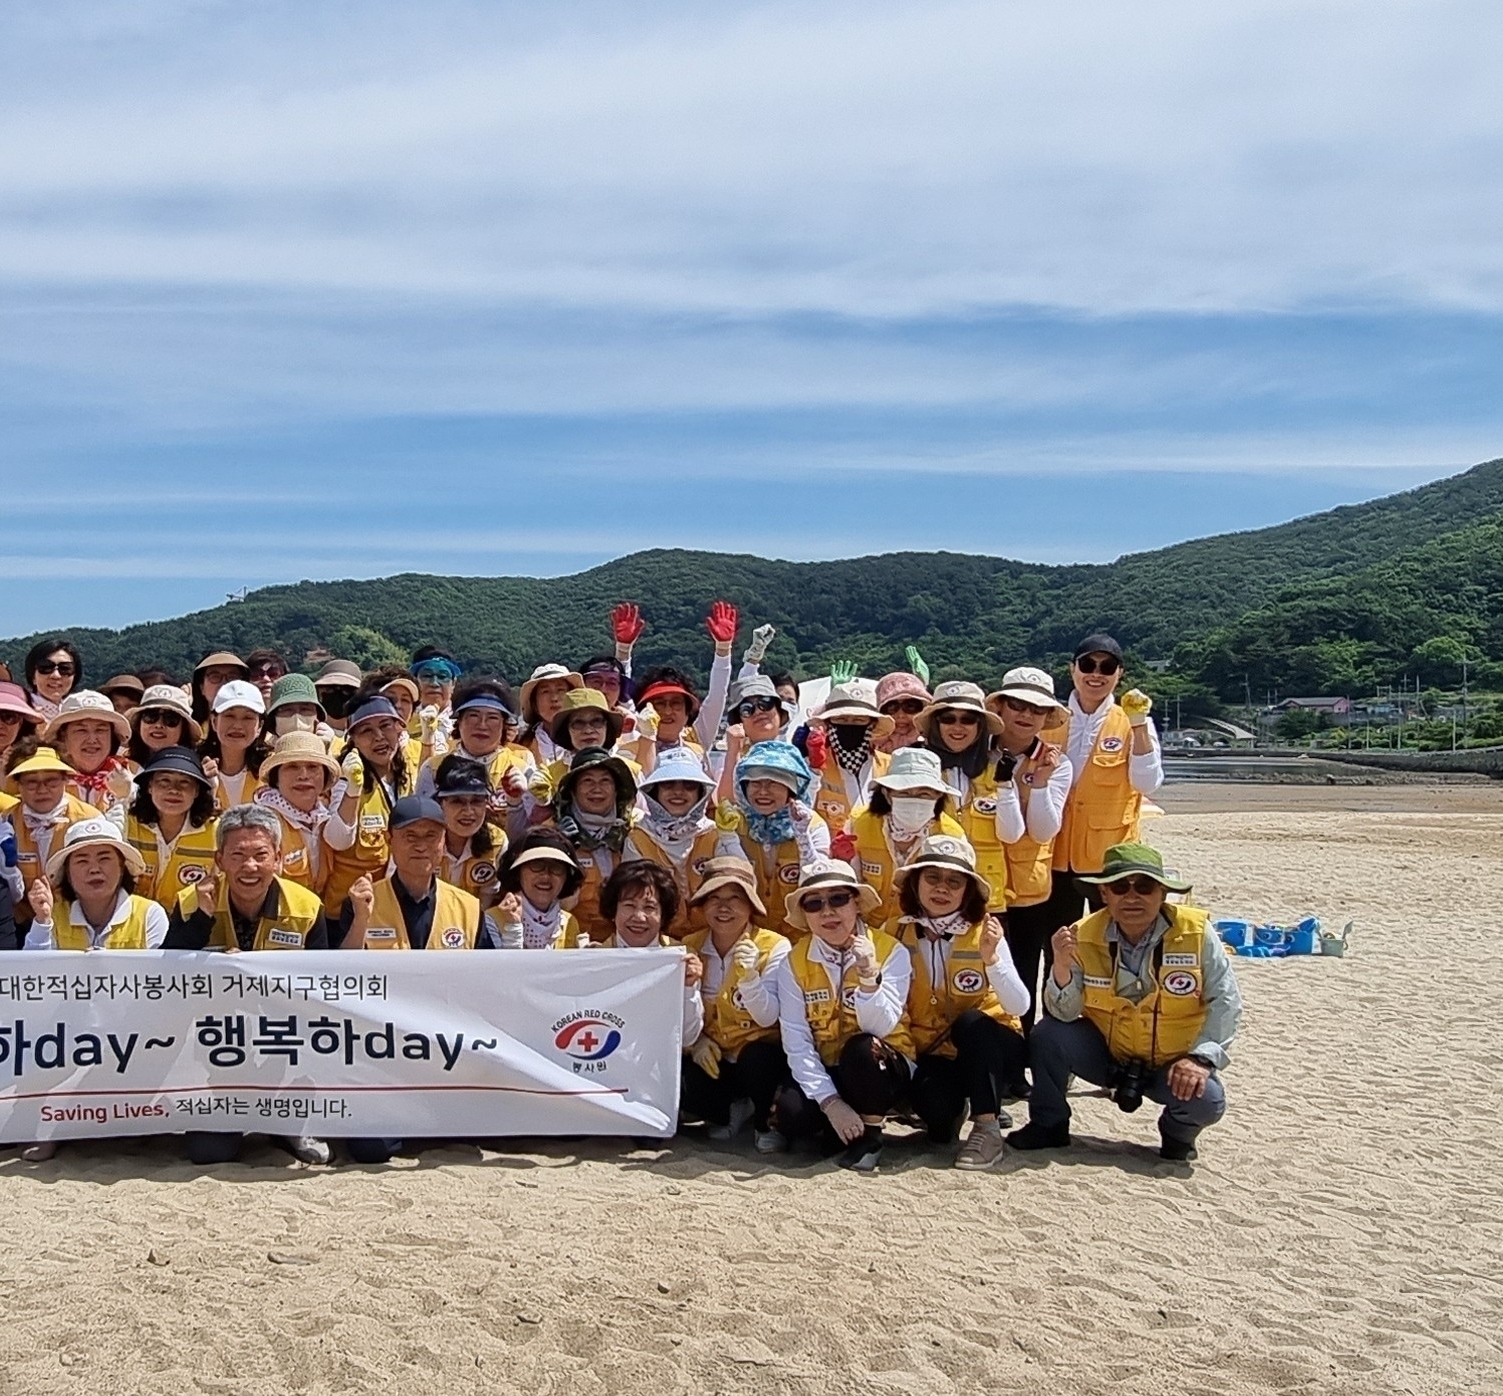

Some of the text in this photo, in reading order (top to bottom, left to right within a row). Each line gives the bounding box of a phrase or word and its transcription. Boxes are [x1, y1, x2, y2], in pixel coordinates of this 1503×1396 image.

[222, 974, 388, 1000] 거제지구협의회
[551, 1009, 625, 1033] KOREAN RED CROSS
[196, 1015, 497, 1071] 행복하day~
[40, 1096, 352, 1123] Saving Lives, 적십자는 생명입니다.
